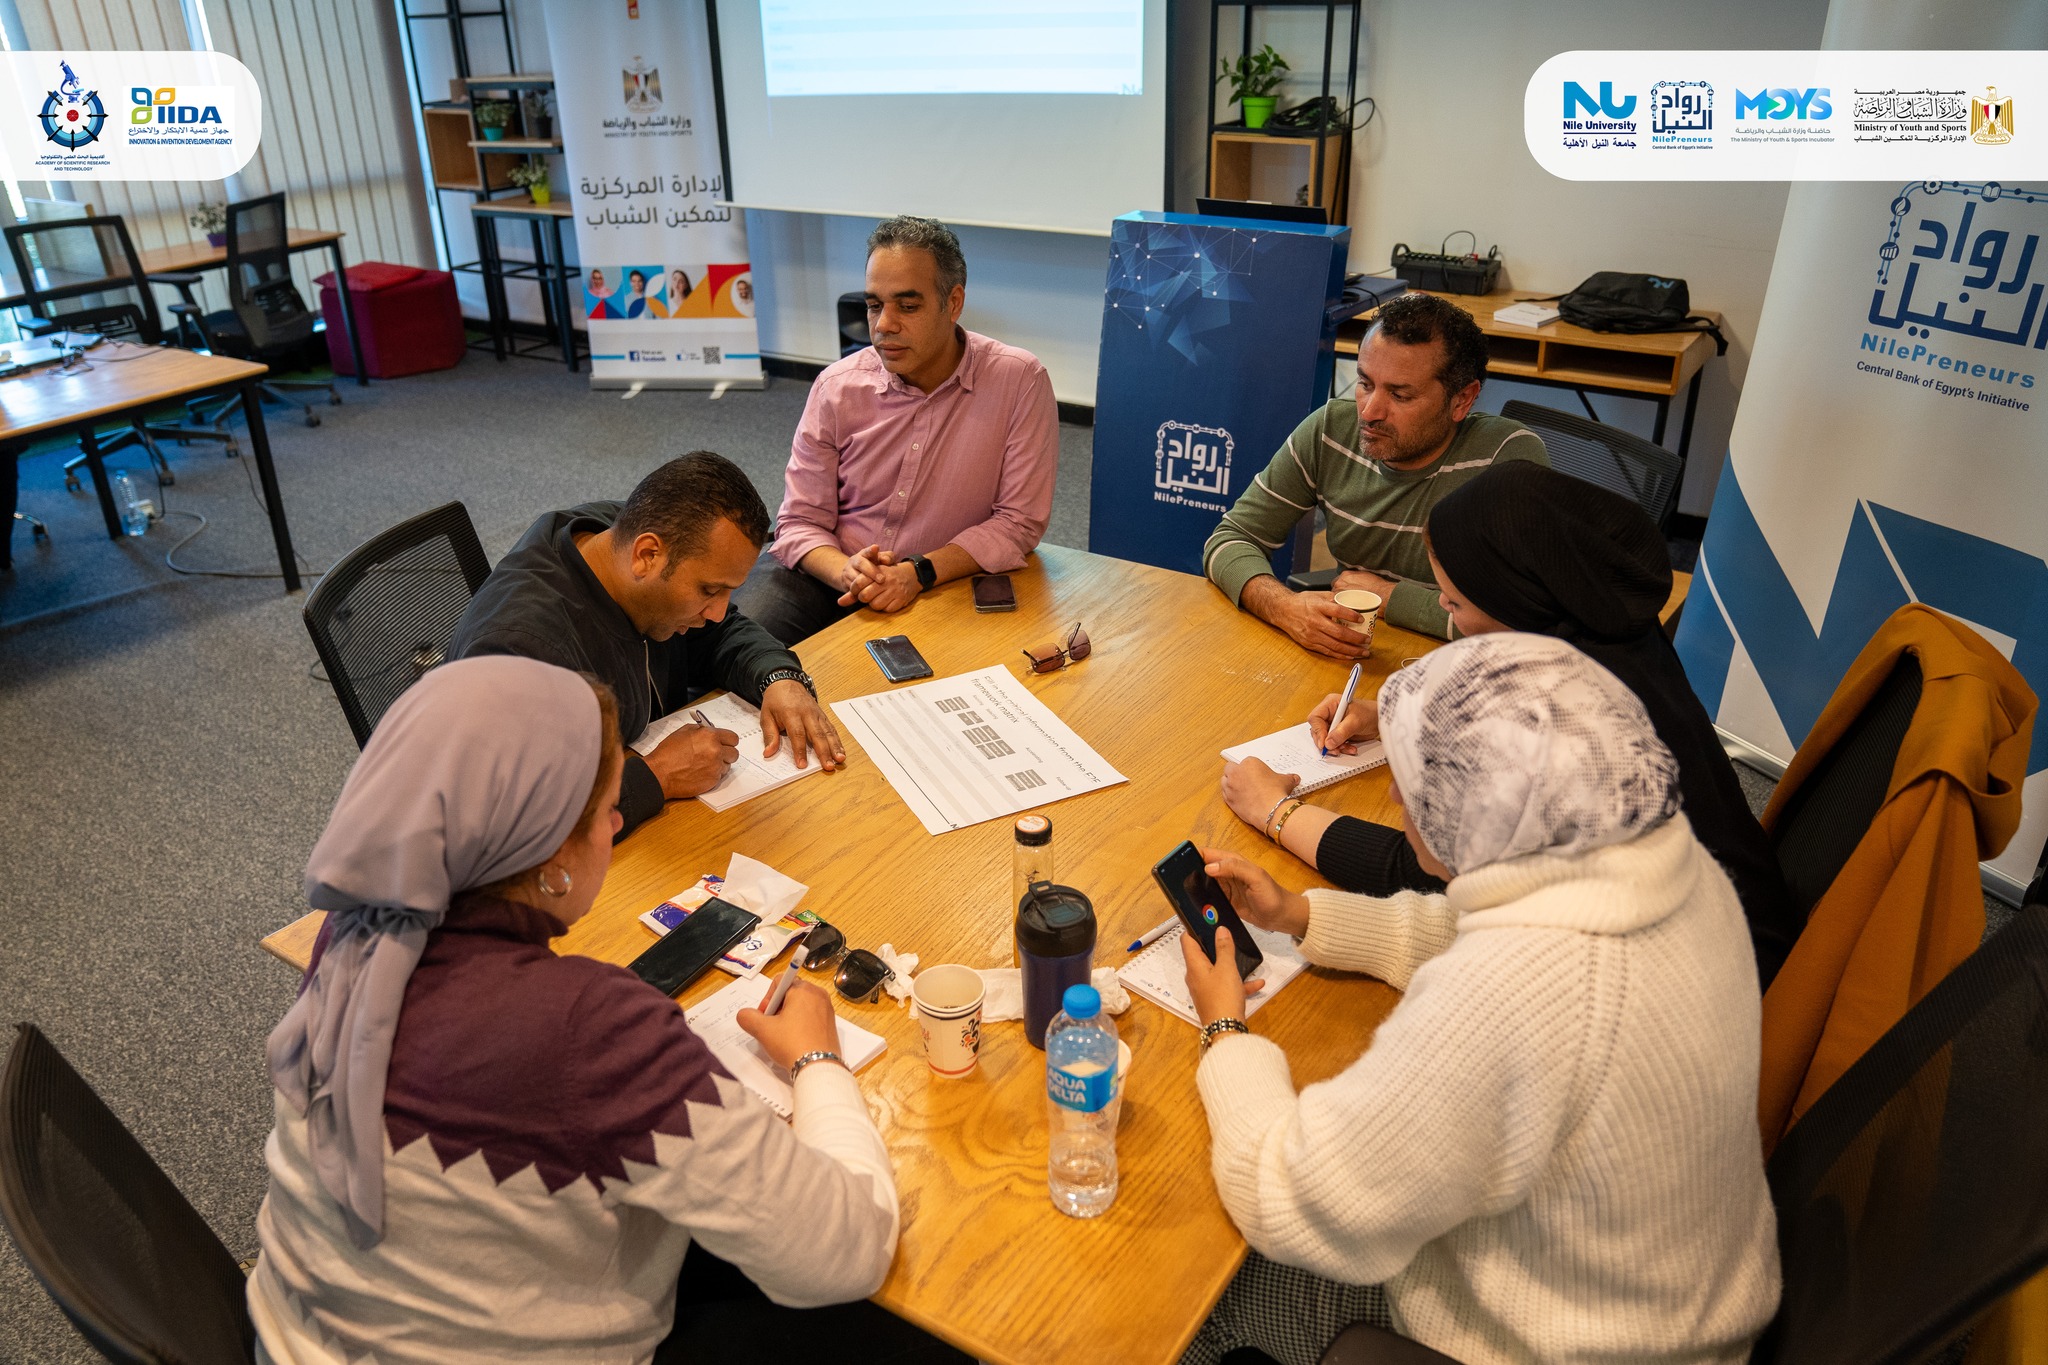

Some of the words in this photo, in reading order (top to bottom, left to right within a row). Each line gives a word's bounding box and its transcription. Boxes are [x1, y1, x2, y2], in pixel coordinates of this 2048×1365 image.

[1860, 332, 2036, 389] NilePreneurs
[1856, 360, 1894, 378] Central
[1896, 370, 1920, 385] Bank
[1922, 378, 1934, 388] of
[1977, 390, 2030, 412] Initiative
[1154, 491, 1227, 513] NilePreneurs
[1048, 1067, 1086, 1092] AQUA
